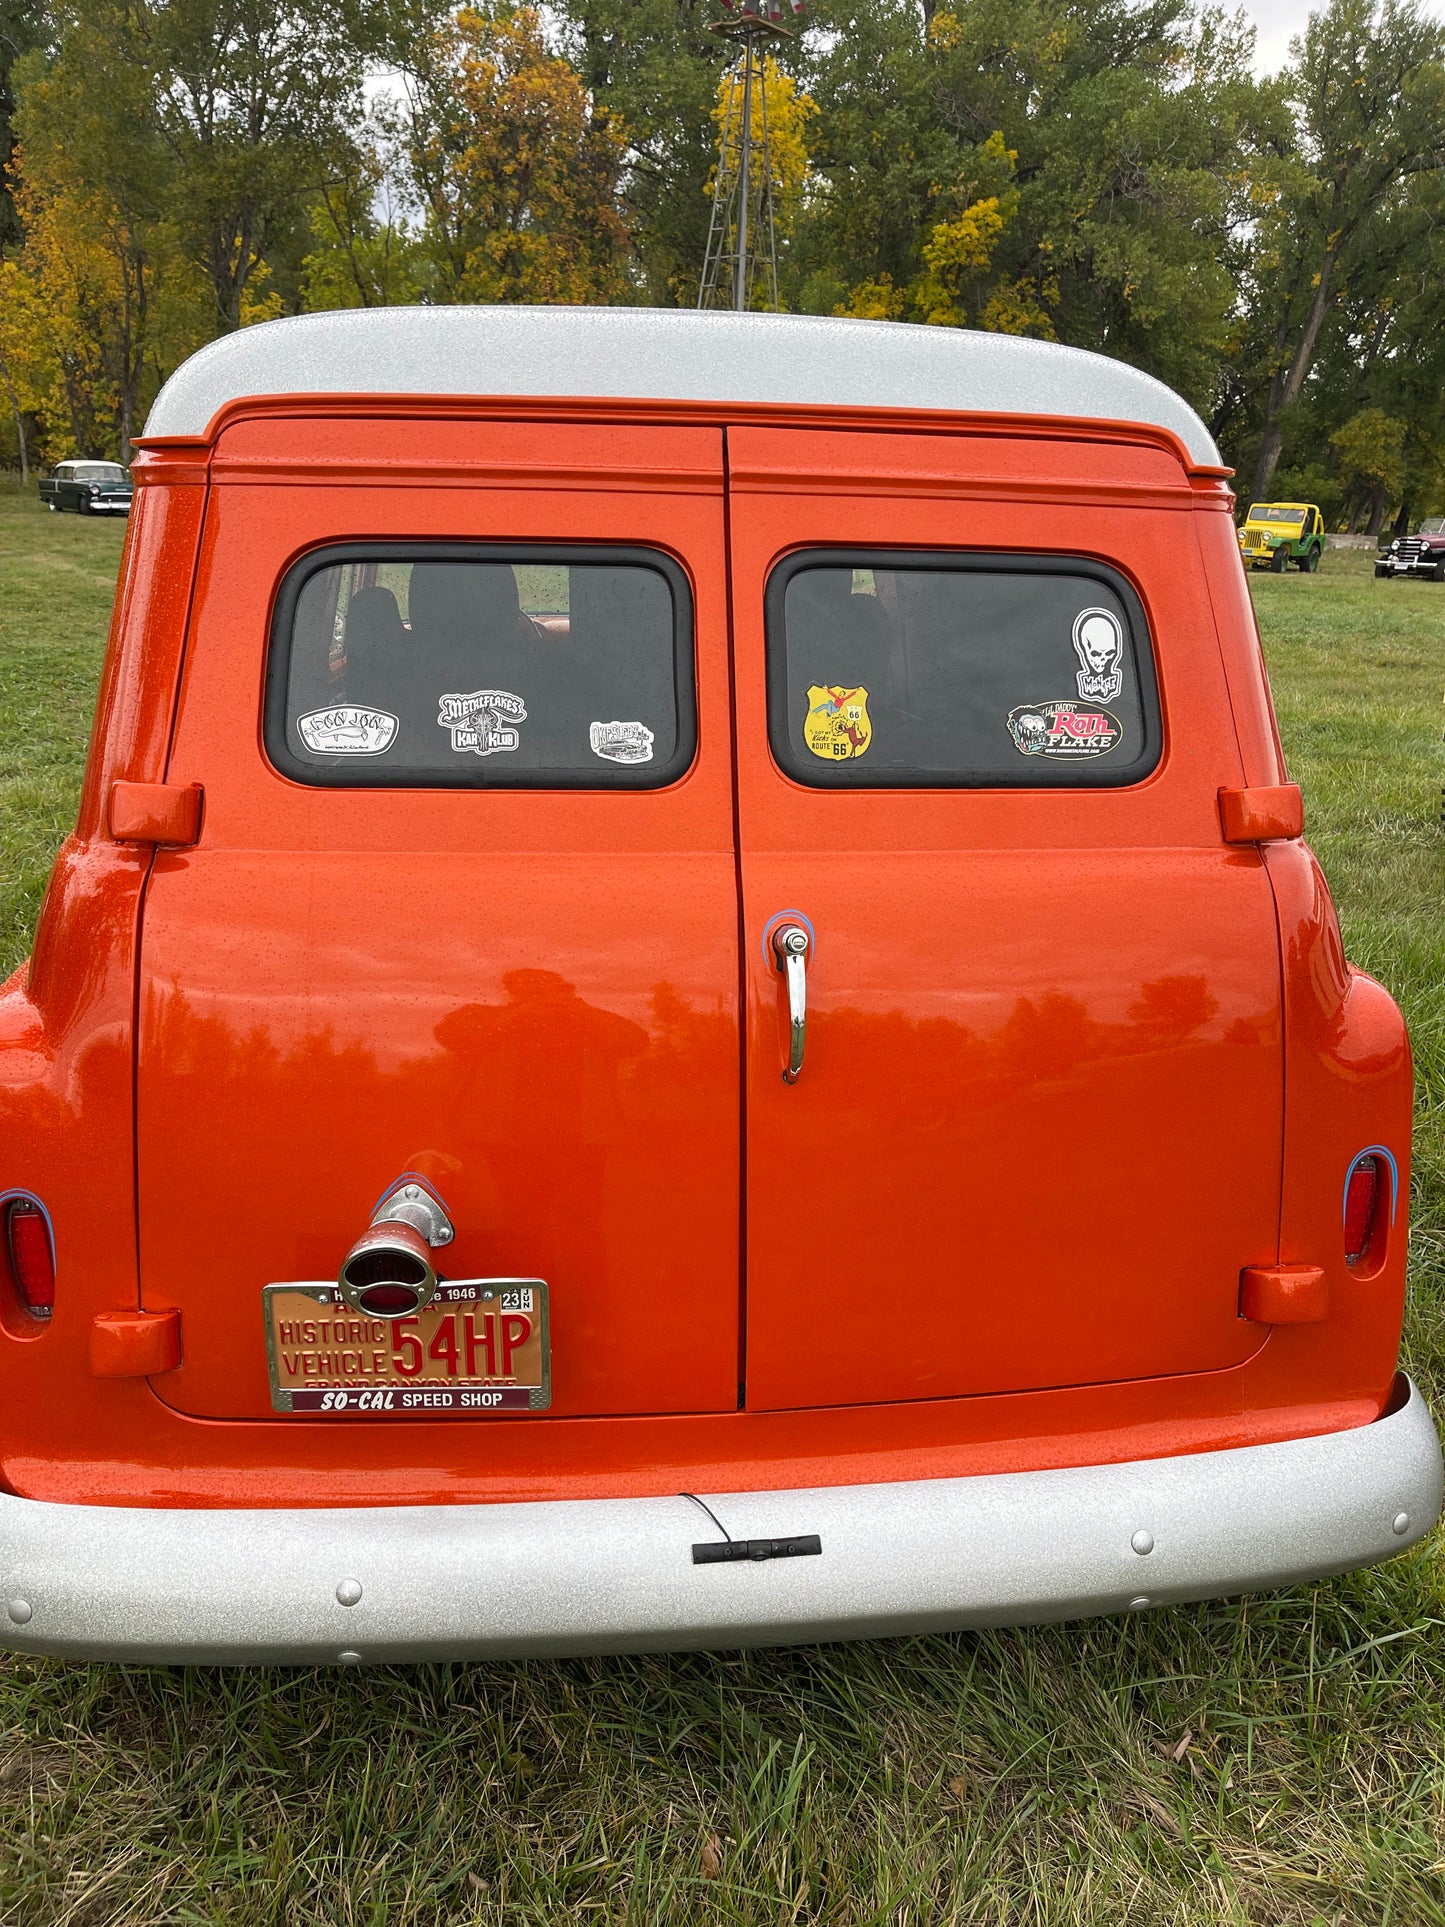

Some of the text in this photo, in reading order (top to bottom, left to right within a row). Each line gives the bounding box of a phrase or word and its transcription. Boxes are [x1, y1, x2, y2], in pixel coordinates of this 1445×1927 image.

[849, 711, 859, 719] 66
[457, 730, 513, 747] KAR KLUB
[1047, 736, 1112, 748] FLAKE
[446, 1287, 476, 1300] 1946
[502, 1293, 520, 1307] 23
[522, 1288, 530, 1308] JUN
[280, 1312, 532, 1376] HISTORIC 54HP
[283, 1350, 388, 1376] VEHICLE
[320, 1391, 503, 1410] SO-CAL SPEED SHOP
